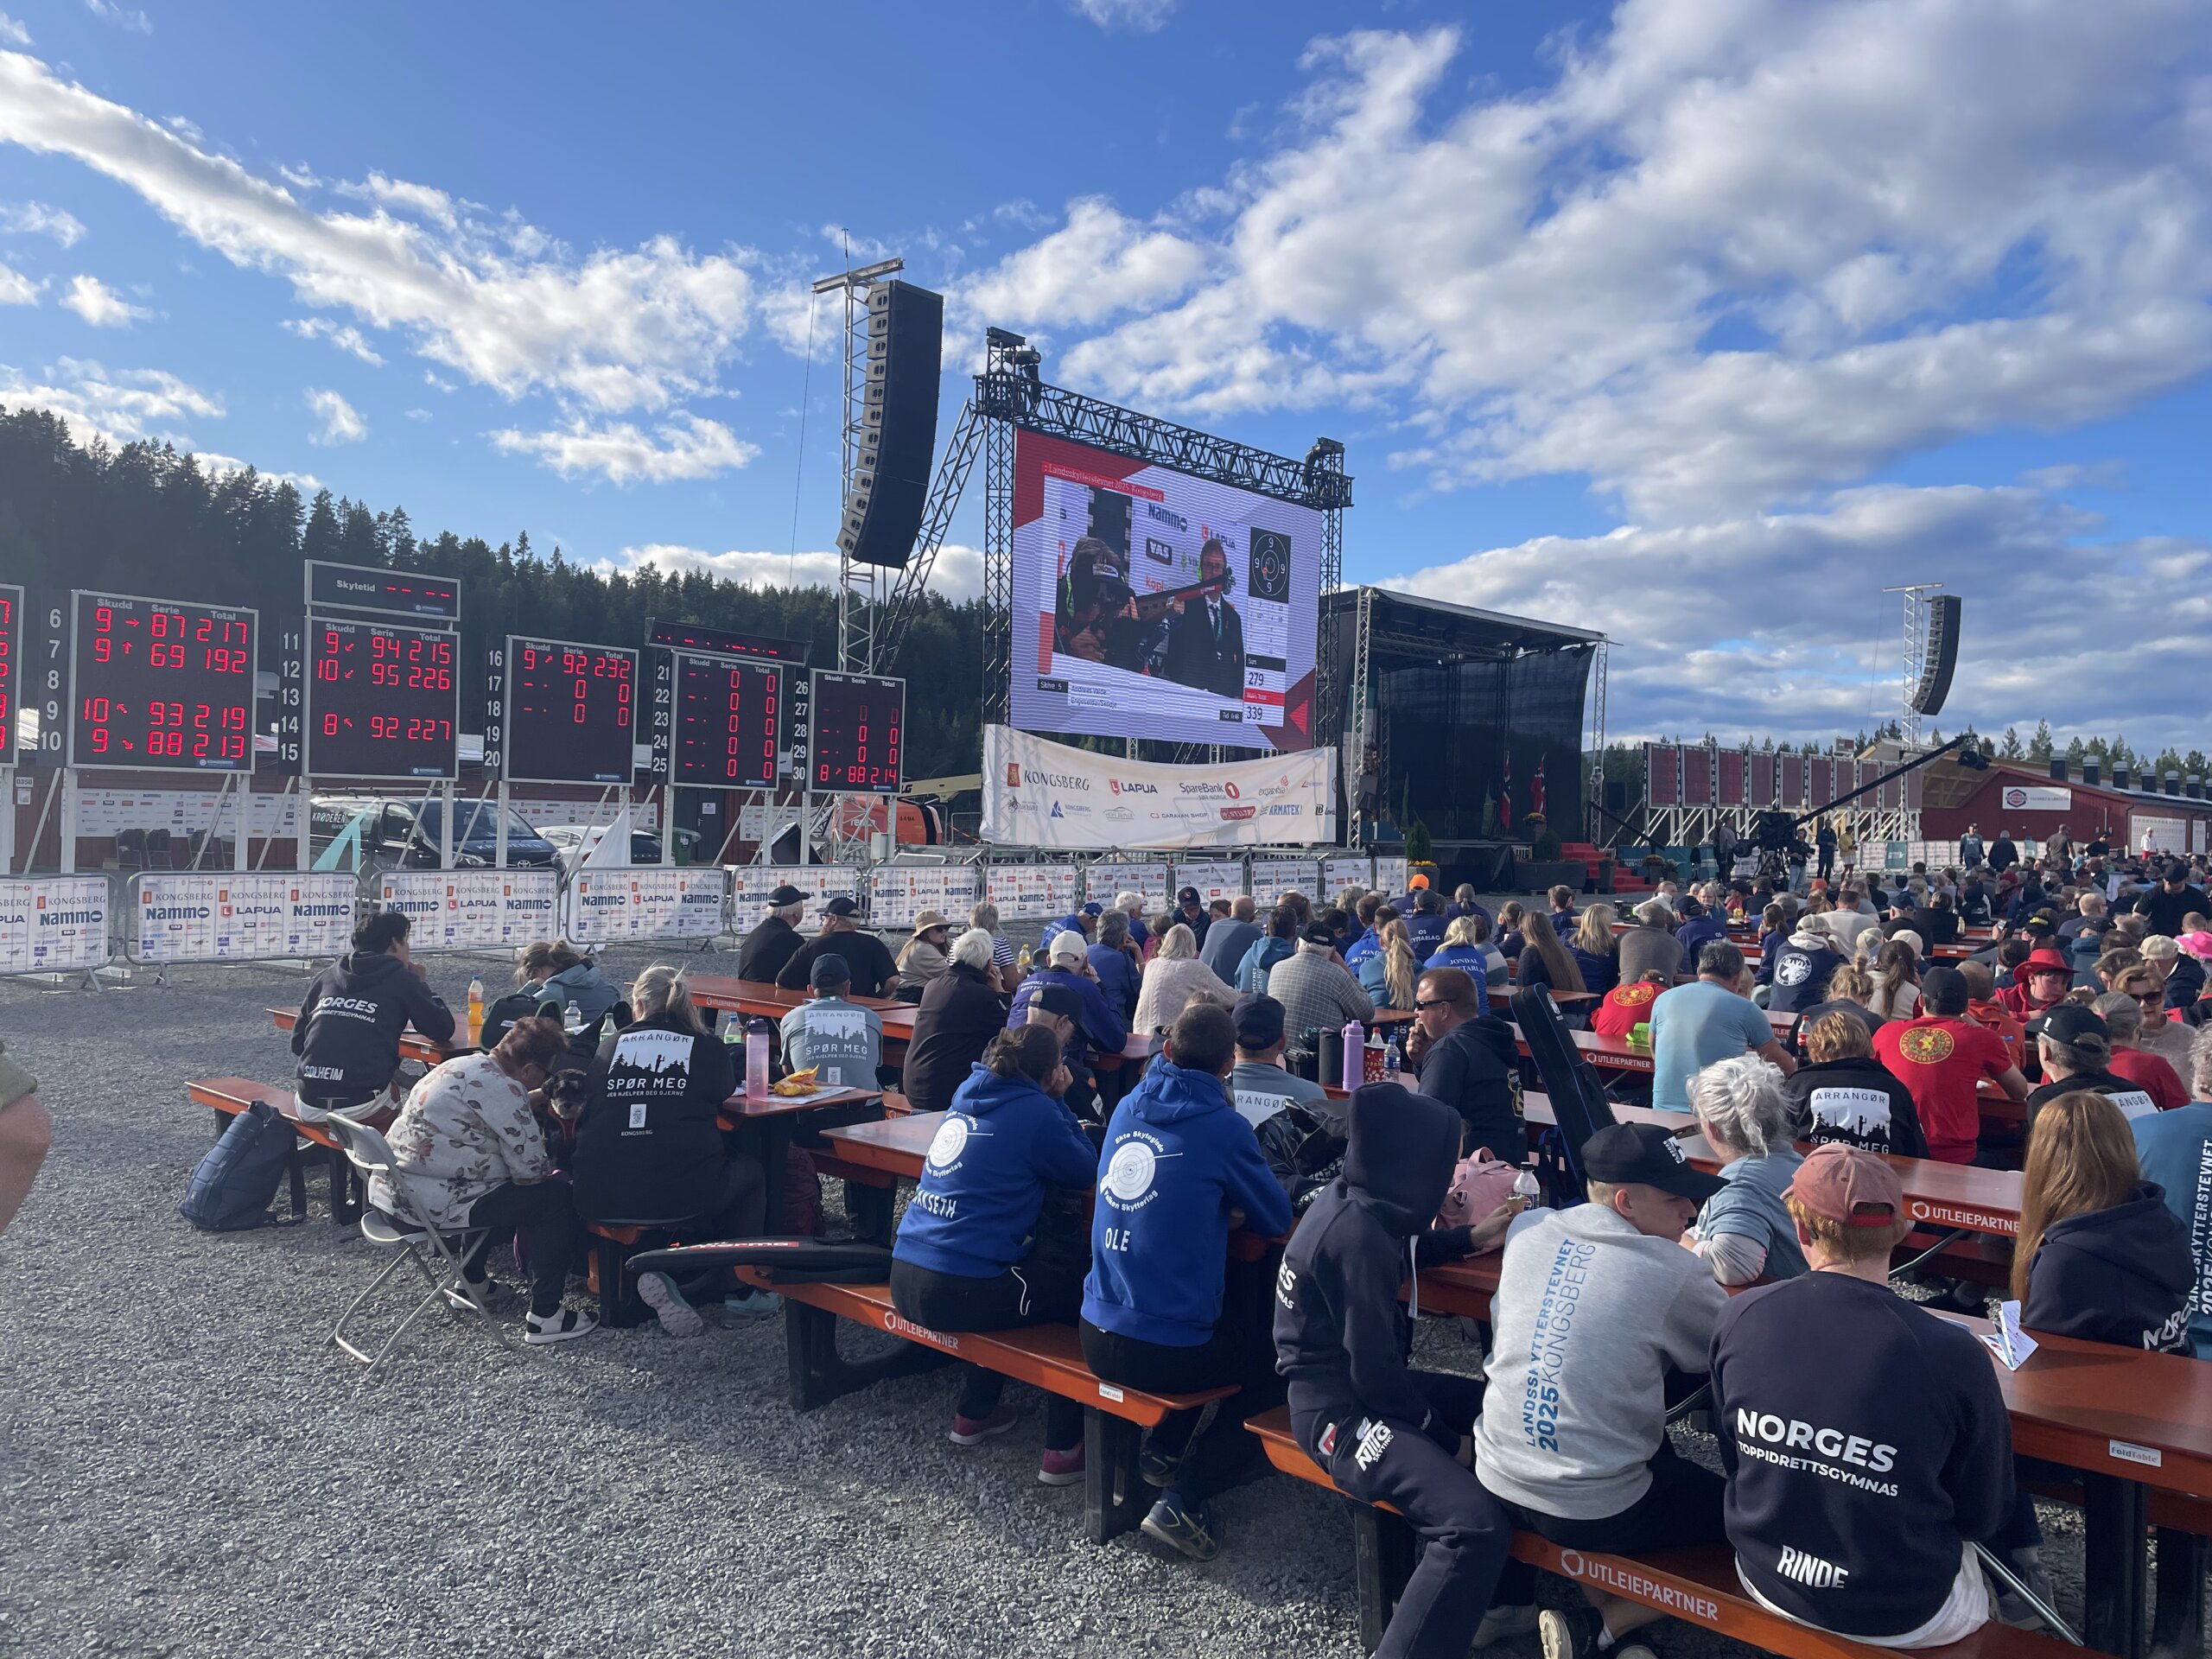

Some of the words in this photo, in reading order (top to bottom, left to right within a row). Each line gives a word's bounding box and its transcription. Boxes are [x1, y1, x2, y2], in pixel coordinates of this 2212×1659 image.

[1268, 537, 1274, 547] 9
[1255, 558, 1260, 568] 9
[1281, 564, 1285, 574] 9
[336, 580, 375, 592] Skytetid
[1267, 582, 1272, 593] 9
[97, 598, 132, 610] Skudd
[152, 605, 180, 614] Serie
[211, 610, 236, 620] Total
[49, 608, 61, 628] 6
[96, 607, 111, 632] 9
[151, 613, 185, 638] 87
[196, 619, 247, 644] 217
[326, 623, 355, 633] Skudd
[371, 628, 394, 638] Serie
[420, 632, 441, 642] Total
[48, 639, 60, 658] 7
[283, 632, 298, 650] 11
[326, 632, 339, 653] 9
[372, 637, 399, 658] 94
[409, 640, 450, 664] 215
[525, 642, 550, 652] Skudd
[95, 638, 111, 663] 9
[150, 643, 185, 668] 69
[206, 648, 246, 673] 192
[489, 651, 502, 666] 16
[283, 661, 300, 678] 12
[524, 650, 535, 670] 9
[563, 654, 587, 675] 92
[594, 658, 630, 679] 232
[318, 659, 338, 681] 10
[372, 664, 398, 685] 95
[409, 667, 449, 690] 226
[657, 665, 669, 680] 21
[1249, 672, 1263, 685] 279
[48, 671, 59, 690] 8
[488, 676, 501, 691] 17
[731, 671, 740, 688] 0
[767, 676, 776, 692] 0
[795, 681, 808, 695] 26
[283, 689, 300, 705] 13
[575, 680, 586, 698] 0
[619, 684, 629, 702] 0
[656, 689, 669, 703] 22
[47, 701, 59, 720] 9
[84, 697, 109, 722] 10
[149, 702, 183, 726] 93
[194, 705, 245, 730] 219
[487, 701, 500, 716] 18
[575, 704, 585, 722] 0
[618, 707, 628, 726] 0
[795, 702, 808, 715] 27
[1247, 707, 1262, 720] 339
[282, 715, 298, 733] 14
[654, 712, 669, 726] 23
[324, 714, 337, 734] 8
[371, 716, 398, 739] 92
[408, 719, 449, 740] 227
[486, 726, 500, 741] 19
[795, 724, 807, 737] 28
[41, 731, 60, 750] 10
[653, 734, 668, 749] 24
[859, 726, 867, 741] 0
[890, 728, 898, 744] 0
[92, 728, 108, 753] 9
[148, 731, 182, 755] 88
[193, 733, 245, 758] 213
[281, 743, 298, 760] 15
[485, 751, 500, 766] 20
[794, 745, 806, 759] 29
[858, 747, 866, 762] 0
[889, 748, 897, 764] 0
[652, 758, 667, 772] 25
[728, 759, 736, 776] 0
[764, 762, 772, 779] 0
[793, 766, 805, 779] 30
[821, 764, 829, 781] 8
[849, 766, 865, 783] 88
[1025, 770, 1090, 791] KONGSBERG
[1122, 783, 1158, 793] LAPUA
[1179, 782, 1224, 794] SpareBank
[1259, 785, 1286, 797] expandia
[312, 812, 346, 823] KRØDEREN
[156, 893, 213, 901] KONGSBERG
[582, 895, 626, 906] Nammo
[682, 894, 719, 904] Nammo
[822, 890, 854, 899] Nammo
[875, 888, 905, 898] Nammo
[1019, 893, 1045, 902] Nammo
[48, 896, 105, 906] KONGSBERG
[387, 901, 439, 912] Nammo
[506, 899, 552, 910] Nammo
[40, 911, 103, 925] Nammo
[146, 907, 210, 919] Nammo
[294, 905, 350, 916] Nammo
[622, 1033, 689, 1043] ARRANGØR
[806, 1044, 837, 1055] SPØR
[844, 1044, 868, 1054] MEG
[1598, 1055, 1650, 1070] UTLEIEPARTNER
[304, 1065, 344, 1080] SOLHEIM
[607, 1078, 646, 1090] SPØR
[653, 1077, 687, 1089] MEG
[1816, 1092, 1885, 1103] ARRANGØR
[1115, 1132, 1130, 1145] Ekte
[1133, 1130, 1164, 1153] Skyteglede
[1122, 1189, 1158, 1212] Skytterlag
[1105, 1227, 1130, 1252] OLE
[897, 1317, 959, 1351] UTLEIEPARTNER
[1373, 1434, 1394, 1462] SKYTING
[1736, 1407, 1898, 1474] NORGES
[1737, 1440, 1899, 1497] TOPPIDRETTSGYMNAS
[1777, 1544, 1849, 1589] RINDE
[1588, 1560, 1719, 1621] UTLEIEPARTNER
